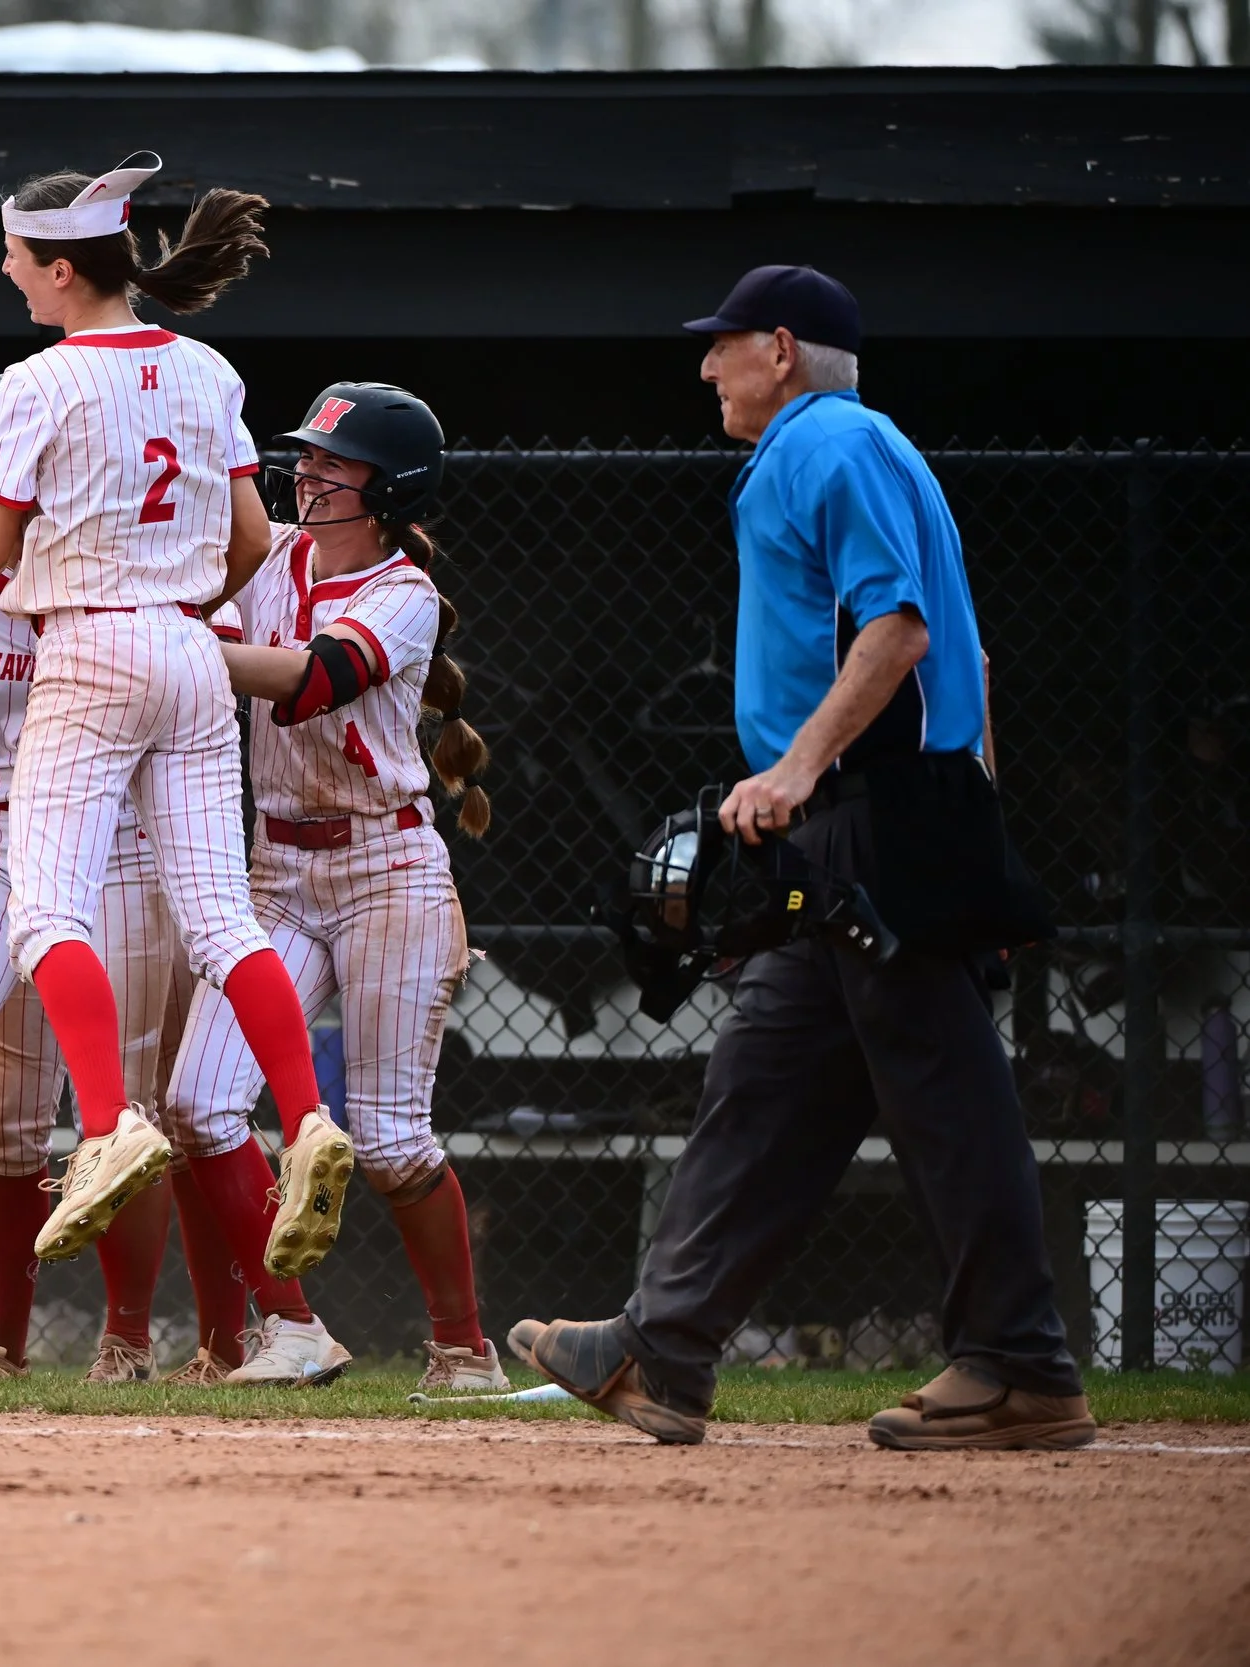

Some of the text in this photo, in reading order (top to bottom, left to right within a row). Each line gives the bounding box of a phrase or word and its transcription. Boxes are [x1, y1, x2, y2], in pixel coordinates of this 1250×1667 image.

[139, 364, 159, 391] H
[305, 396, 356, 433] H
[138, 436, 182, 524] 2
[343, 720, 379, 778] 4
[1160, 1291, 1192, 1307] ON
[1160, 1307, 1236, 1327] SPORTS
